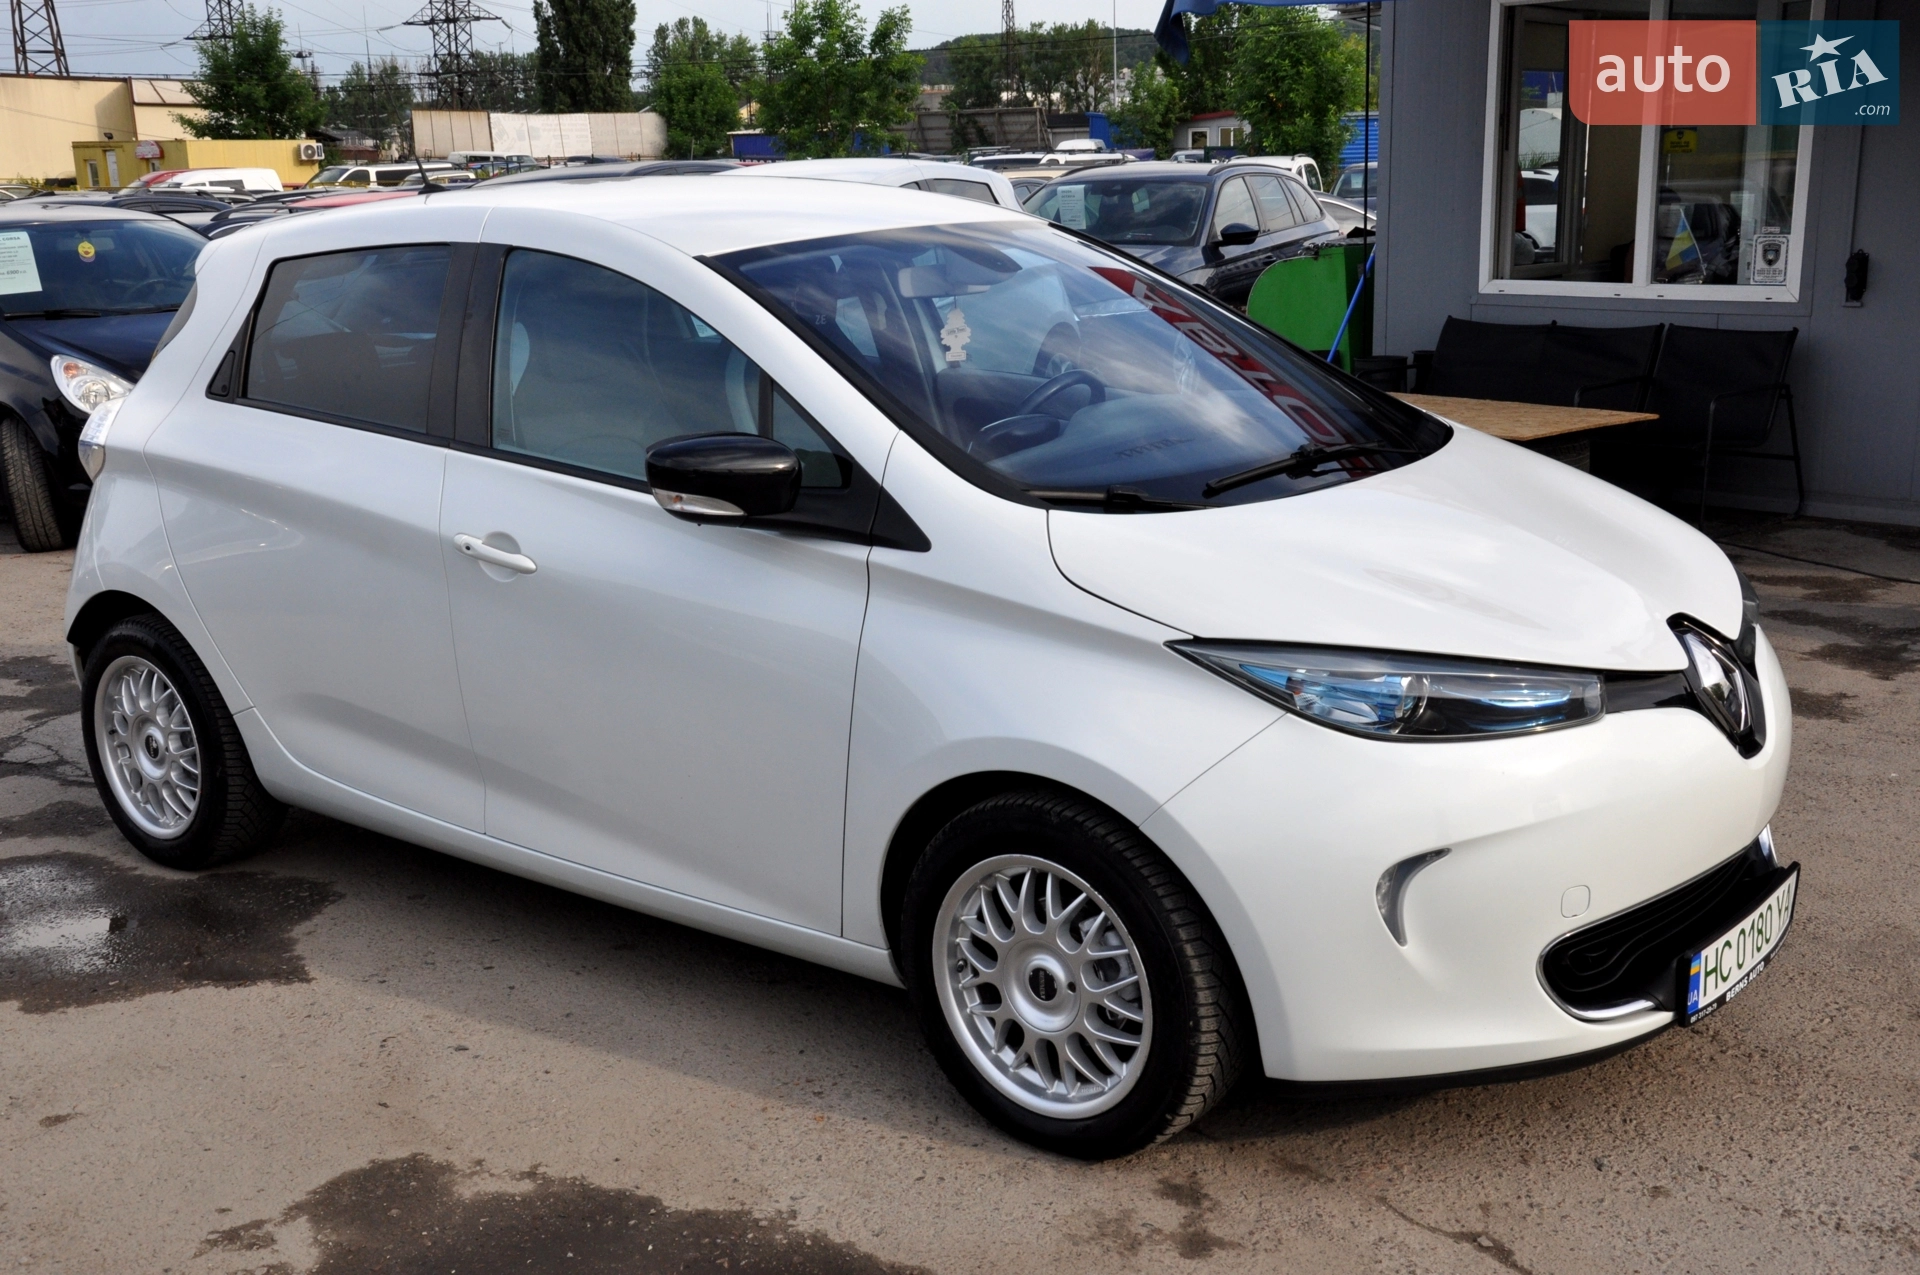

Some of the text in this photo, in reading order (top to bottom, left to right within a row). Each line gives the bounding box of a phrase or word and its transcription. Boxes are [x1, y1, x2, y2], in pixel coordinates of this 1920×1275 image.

[1703, 939, 1733, 998] HC
[1736, 903, 1773, 970] 0180
[1776, 883, 1792, 933] YA
[1748, 961, 1765, 983] AUTO
[1687, 989, 1699, 1006] UA
